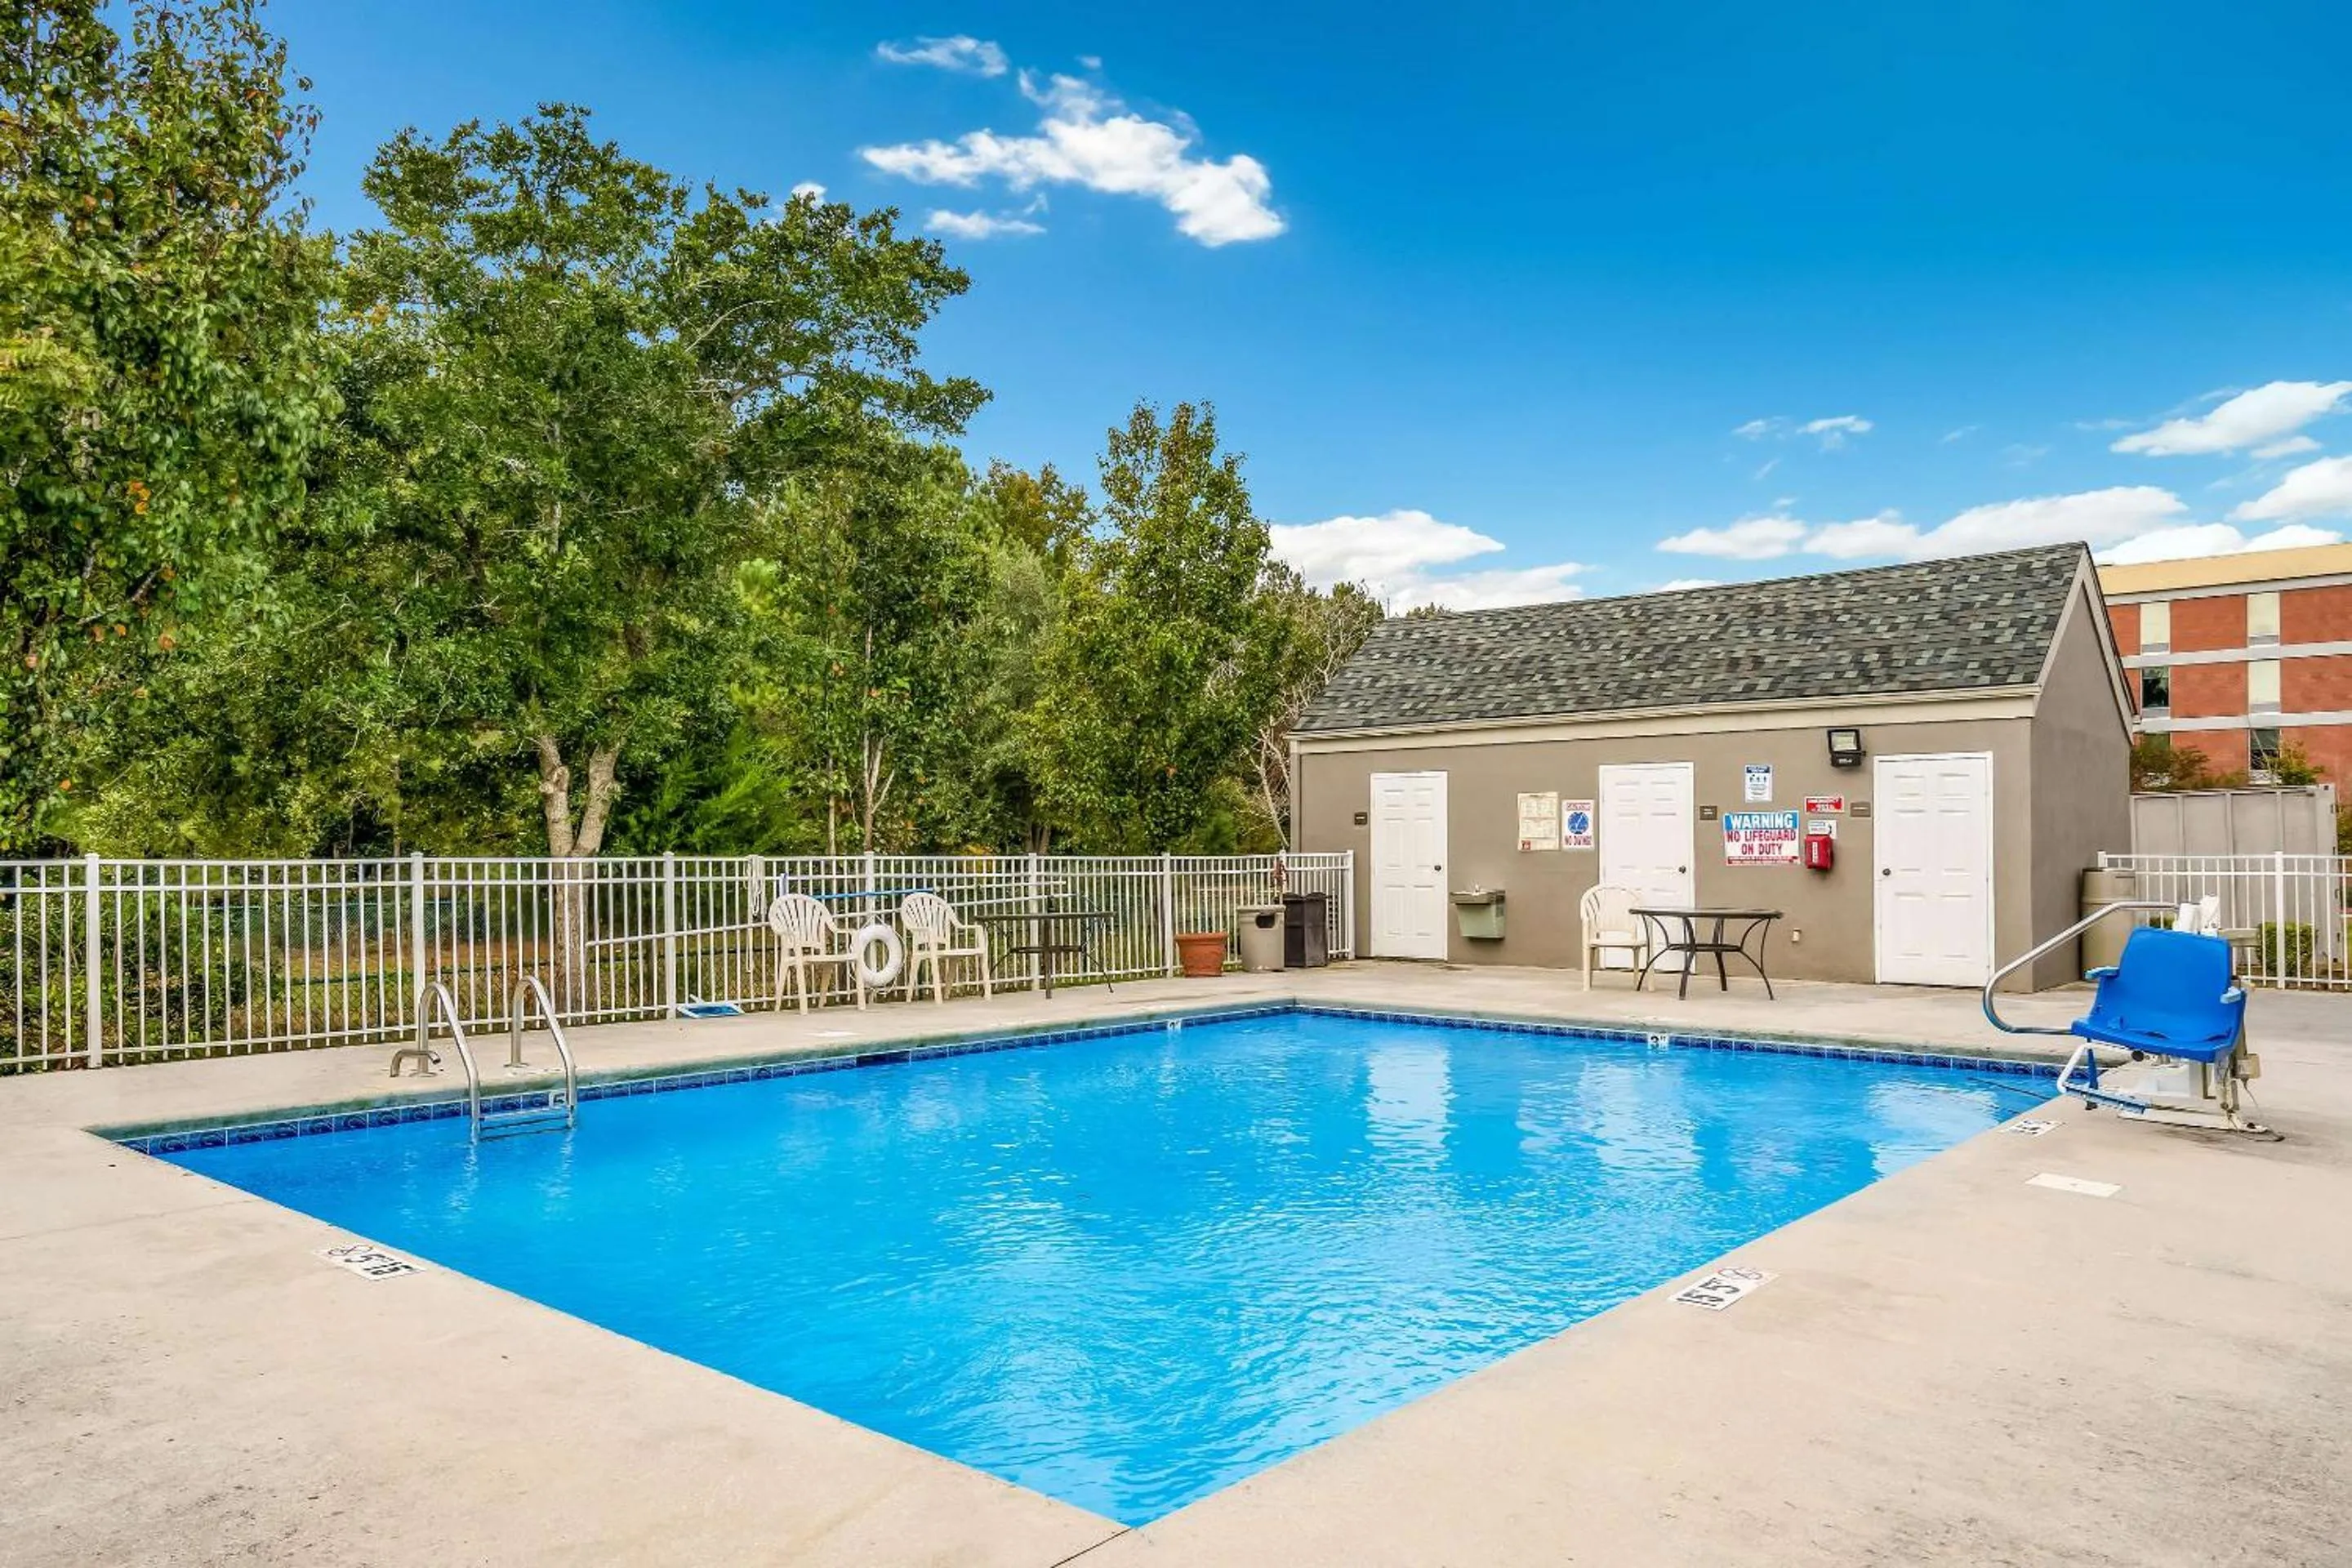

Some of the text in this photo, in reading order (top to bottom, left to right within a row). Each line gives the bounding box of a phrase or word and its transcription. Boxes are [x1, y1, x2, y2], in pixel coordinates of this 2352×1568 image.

[1731, 813, 1793, 830] WARNING
[1727, 830, 1796, 842] NO LIFEGUARD
[1741, 844, 1783, 855] ON DUTY
